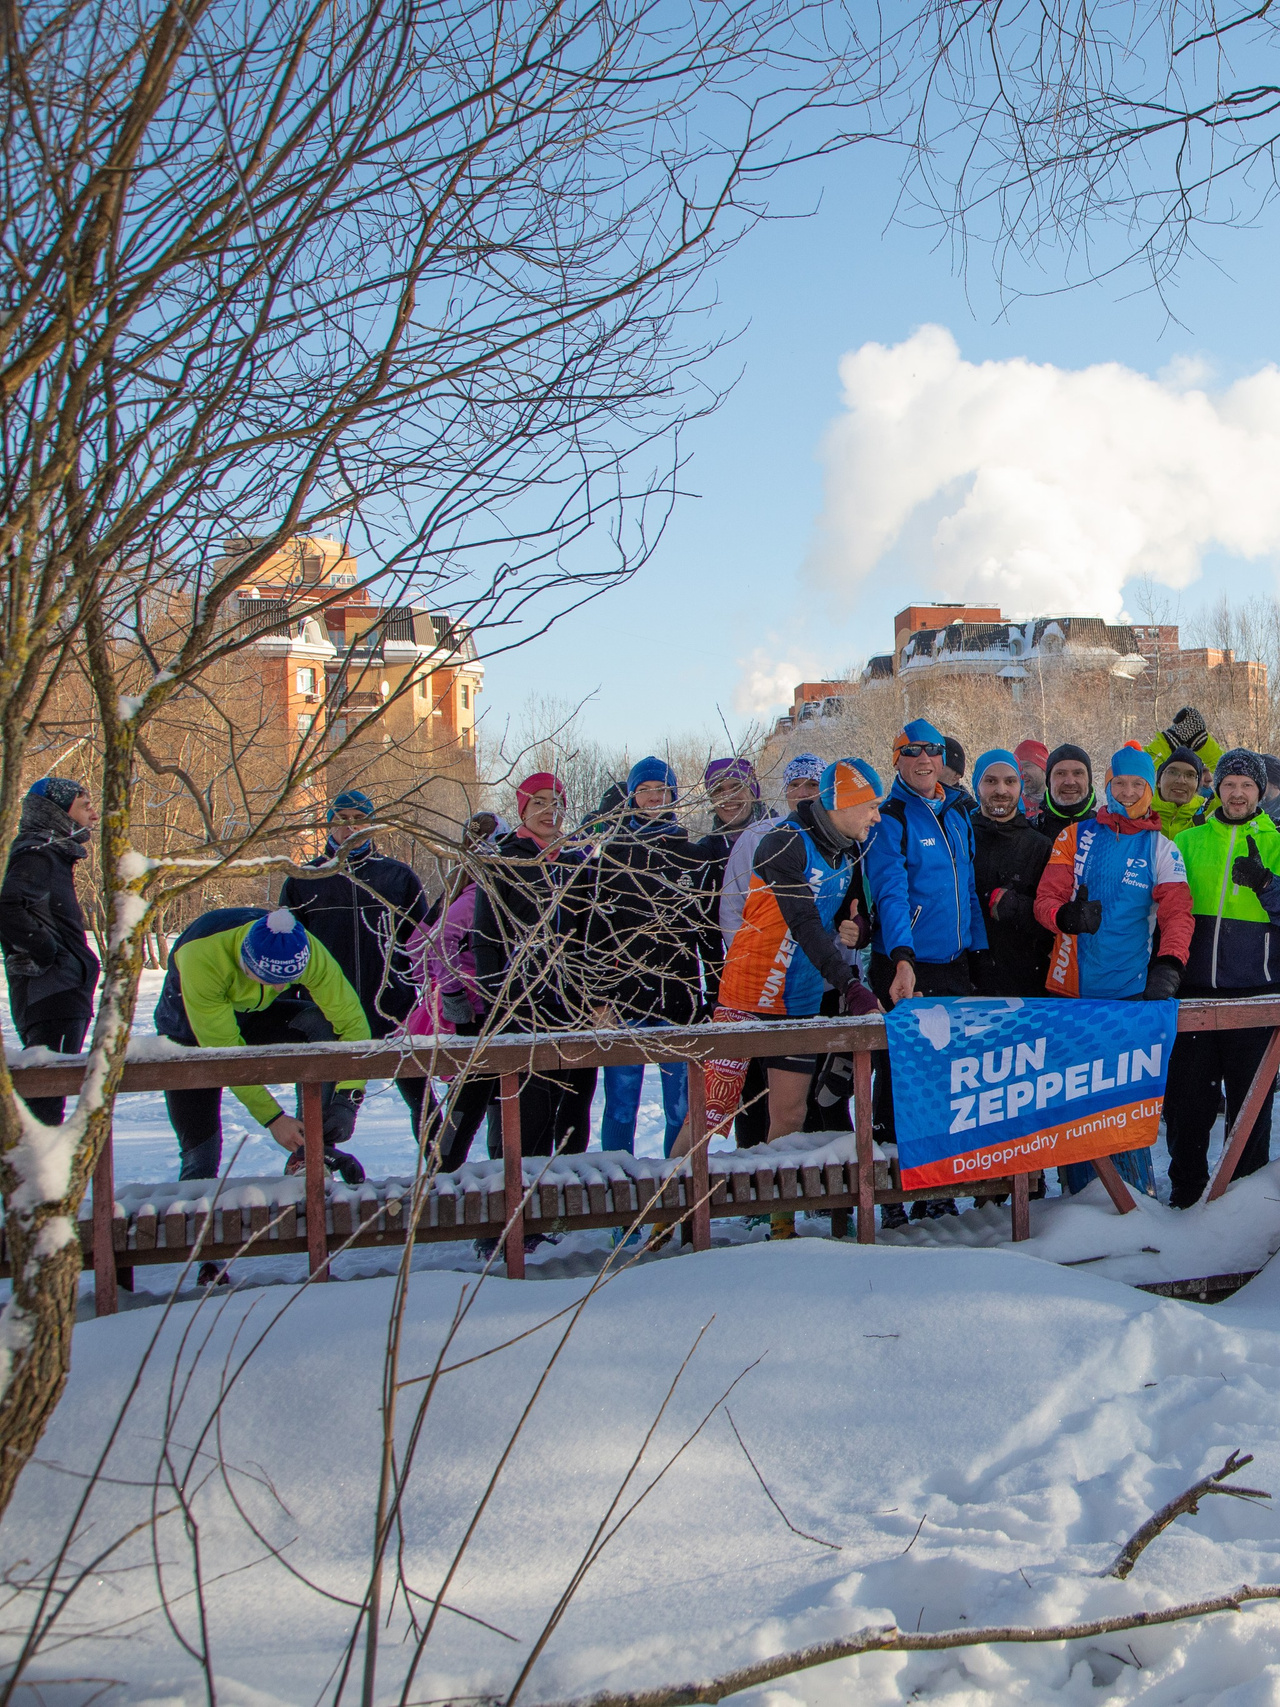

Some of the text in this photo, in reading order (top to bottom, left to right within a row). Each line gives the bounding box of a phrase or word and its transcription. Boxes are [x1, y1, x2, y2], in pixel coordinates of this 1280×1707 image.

[1124, 869, 1139, 878] Igor
[261, 955, 296, 965] VLADIMIR
[1052, 933, 1073, 985] RUN
[757, 968, 786, 1009] RUN
[949, 1043, 1162, 1135] ZEPPELIN
[950, 1037, 1047, 1094] RUN
[953, 1100, 1164, 1174] Dolgoprudny running club
